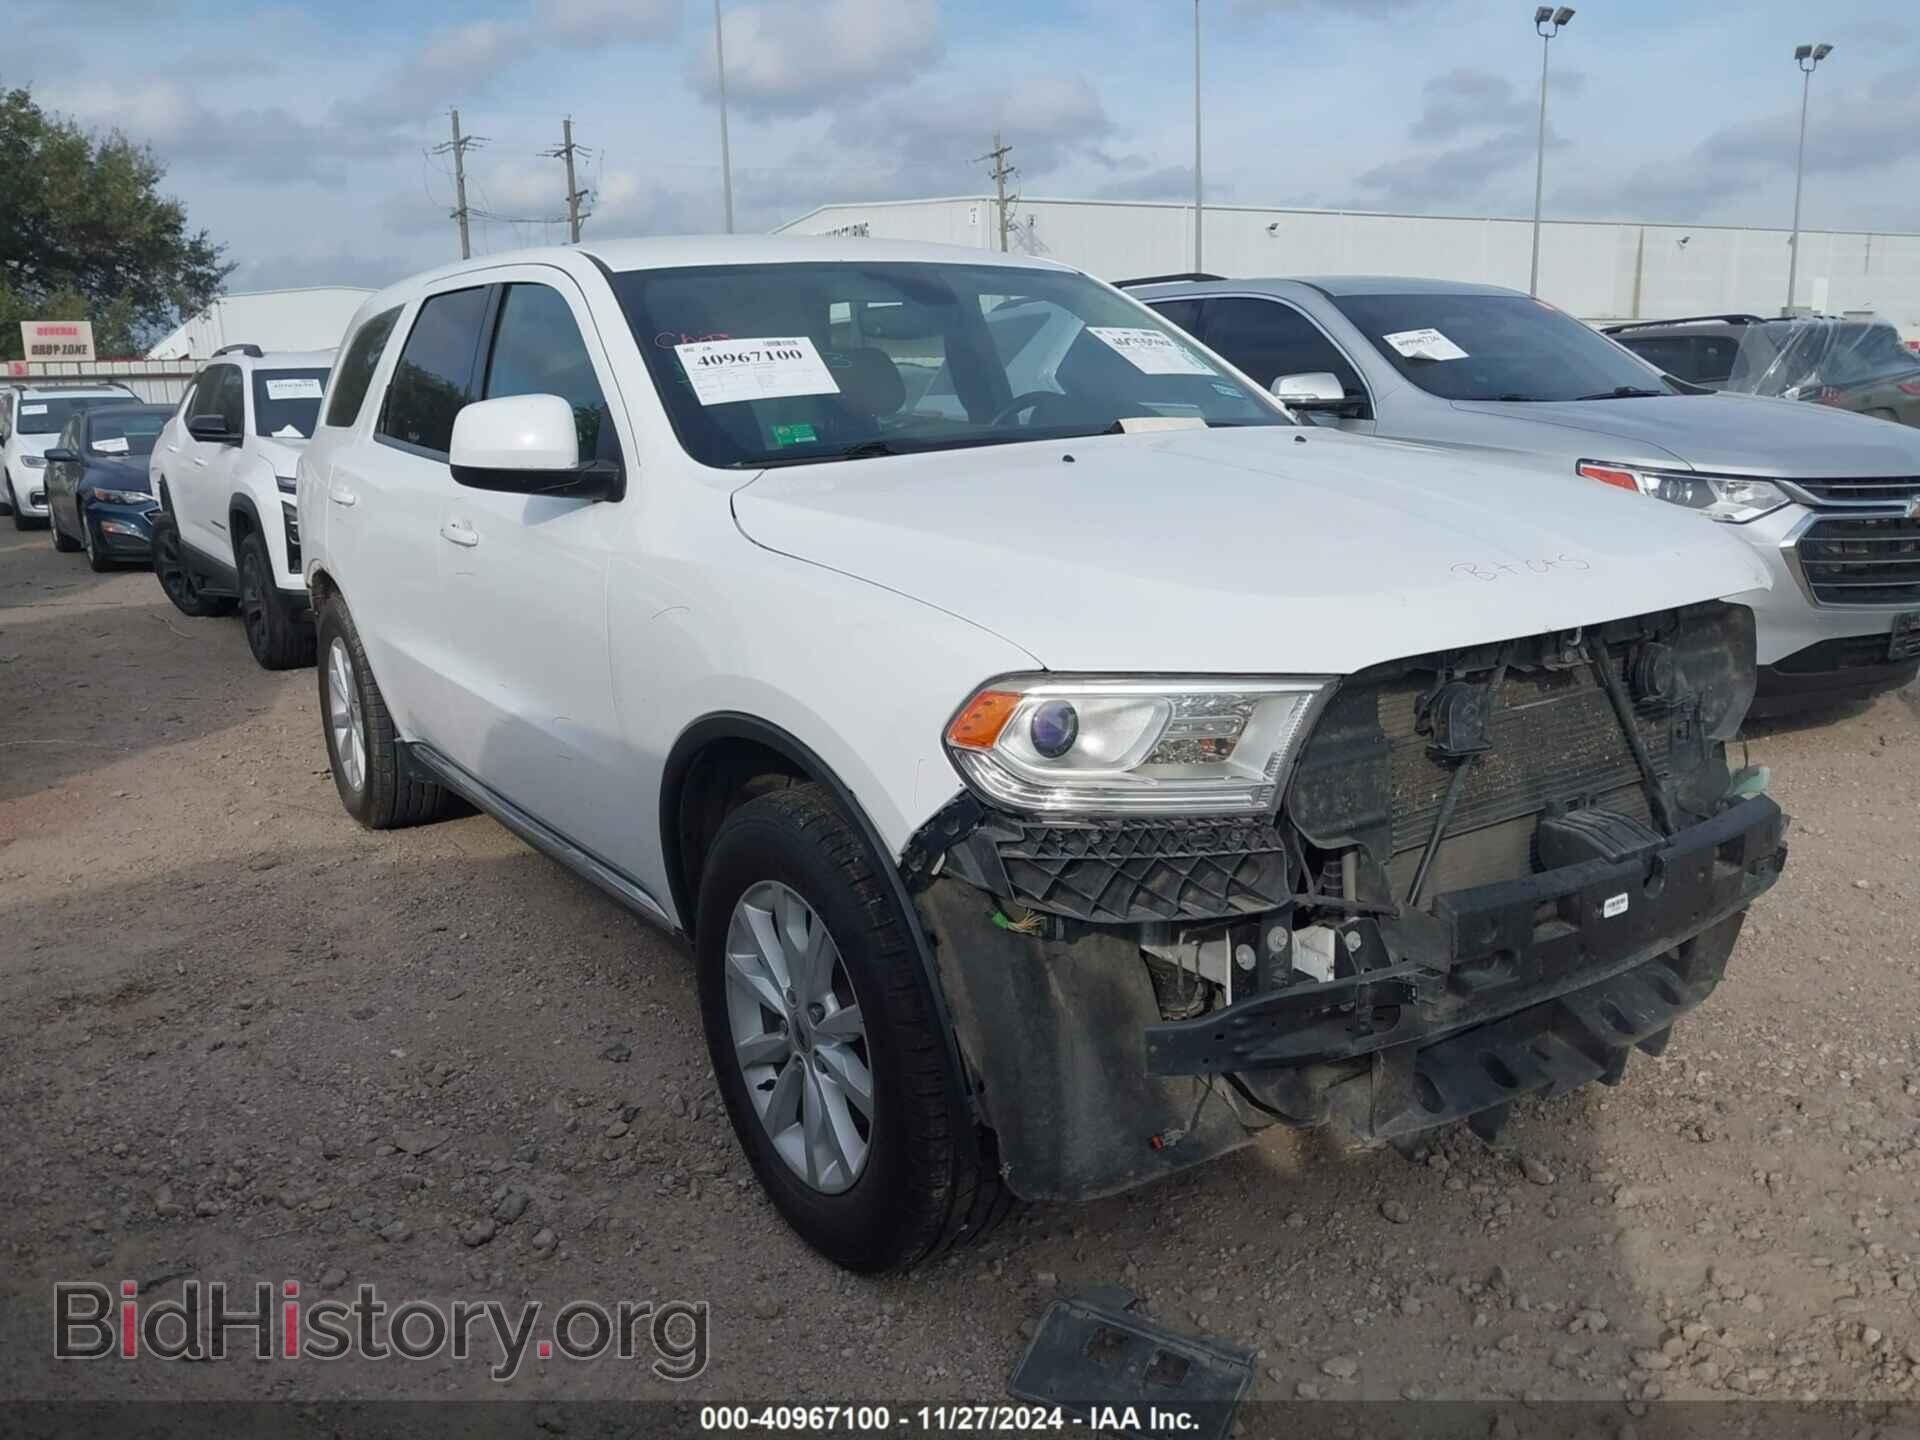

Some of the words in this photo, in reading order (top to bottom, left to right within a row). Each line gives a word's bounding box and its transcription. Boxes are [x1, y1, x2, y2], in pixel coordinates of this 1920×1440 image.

[31, 344, 60, 355] DROP
[62, 344, 88, 355] ZONE
[697, 348, 803, 367] 40967100
